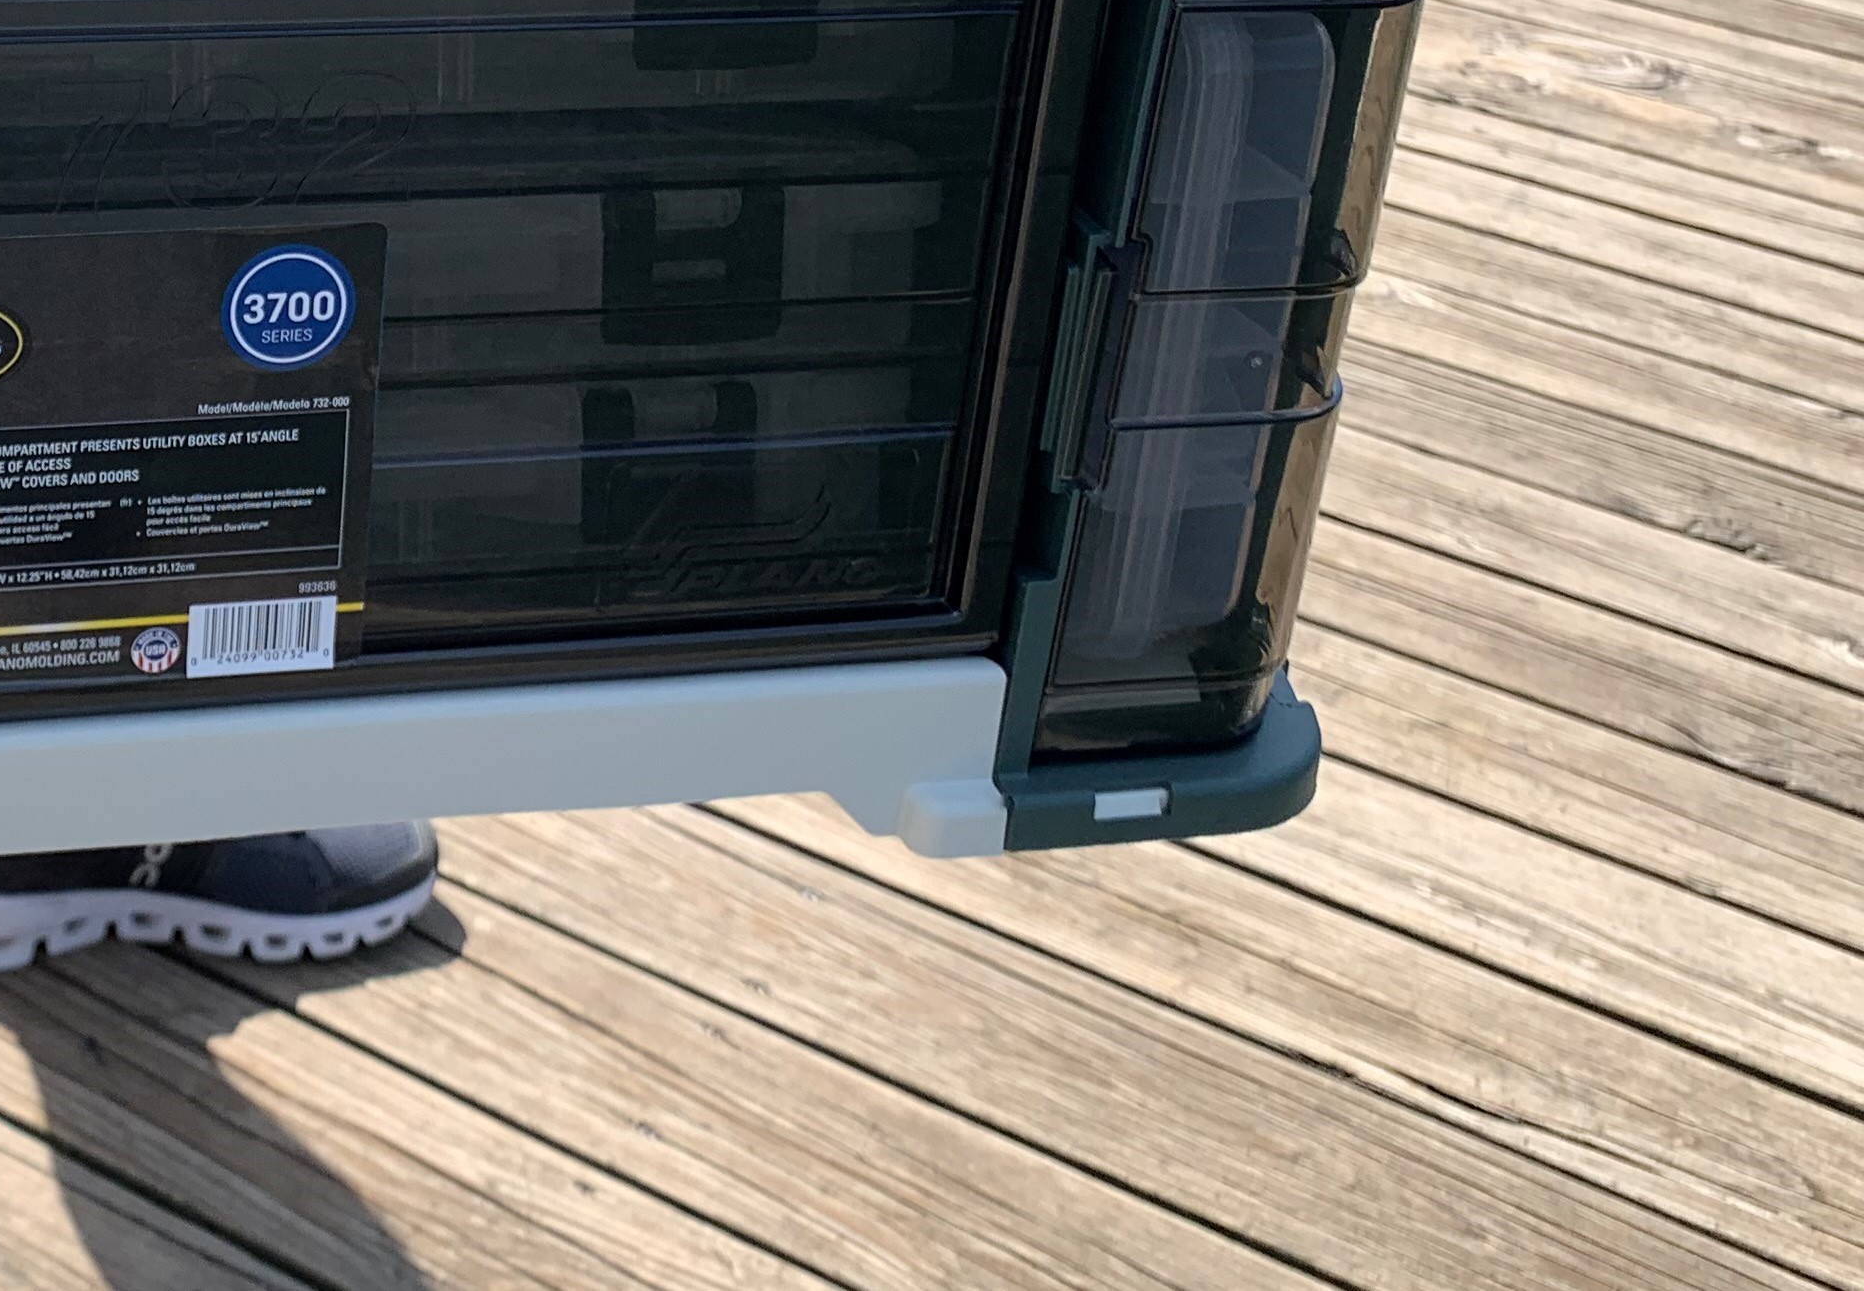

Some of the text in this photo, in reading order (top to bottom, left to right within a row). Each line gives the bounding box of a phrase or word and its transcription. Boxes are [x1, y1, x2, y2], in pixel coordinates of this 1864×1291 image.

[242, 290, 335, 325] 3700
[261, 328, 313, 344] SERIES
[312, 396, 350, 409] 732-000
[80, 437, 141, 453] PRESENTS
[142, 435, 186, 450] UTILITY
[187, 432, 226, 447] BOXES
[227, 431, 244, 445] AT
[7, 459, 24, 474] OF
[24, 457, 72, 472] ACCESS
[22, 473, 69, 489] COVERS
[70, 471, 97, 486] AND
[99, 468, 140, 484] DOORS
